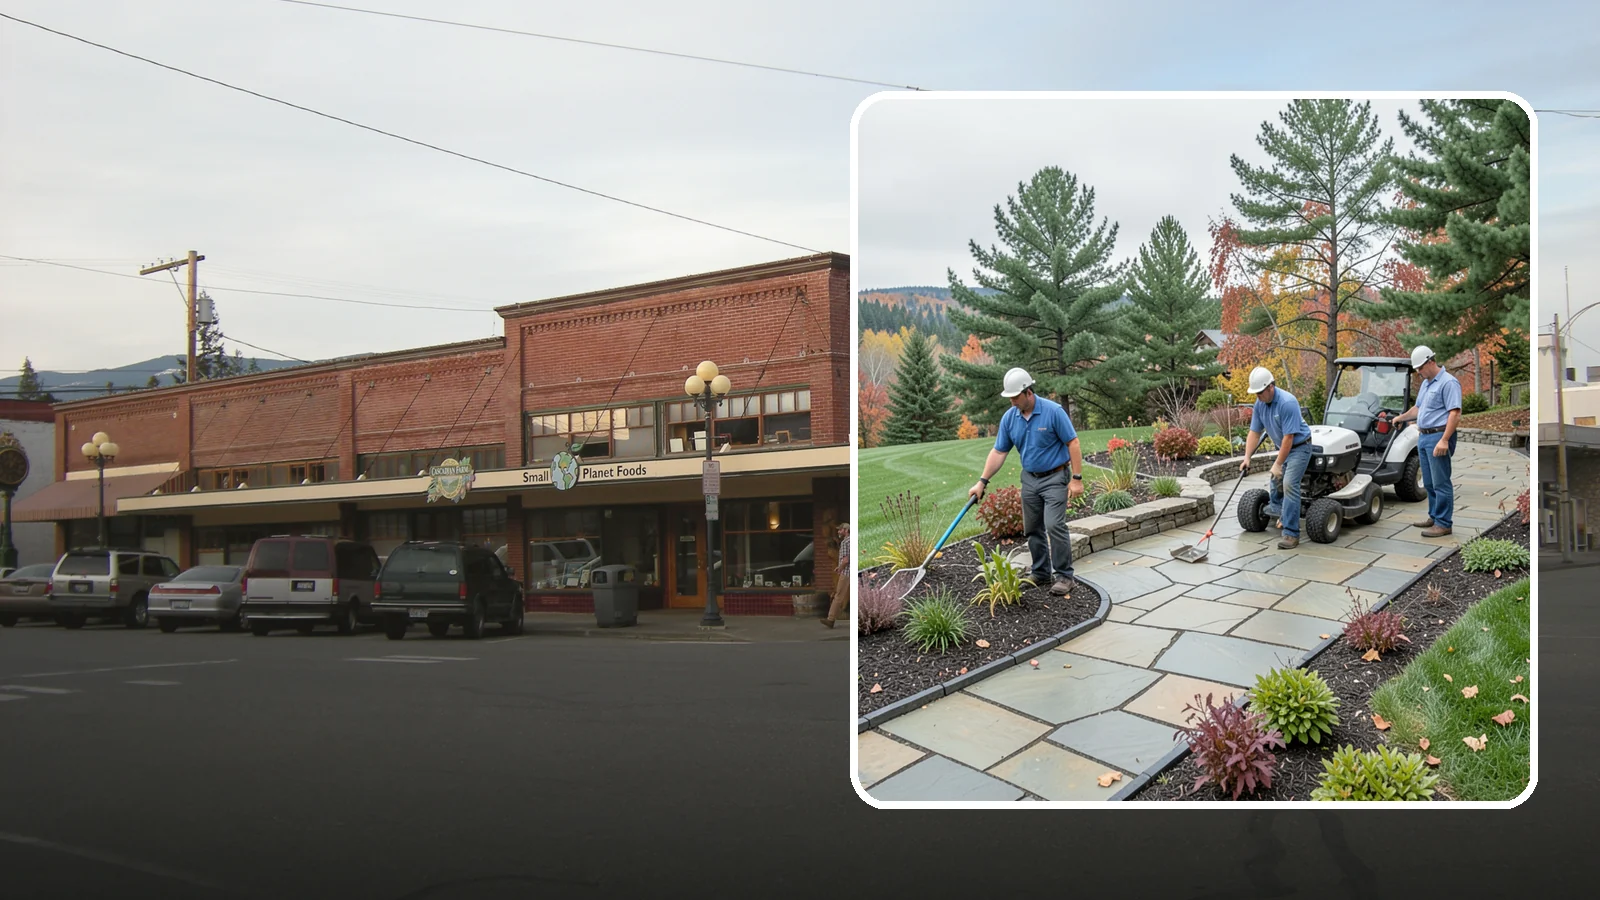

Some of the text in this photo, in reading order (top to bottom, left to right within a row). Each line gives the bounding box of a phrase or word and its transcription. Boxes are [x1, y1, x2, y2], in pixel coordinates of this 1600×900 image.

[523, 464, 647, 483] Small Planet Foods
